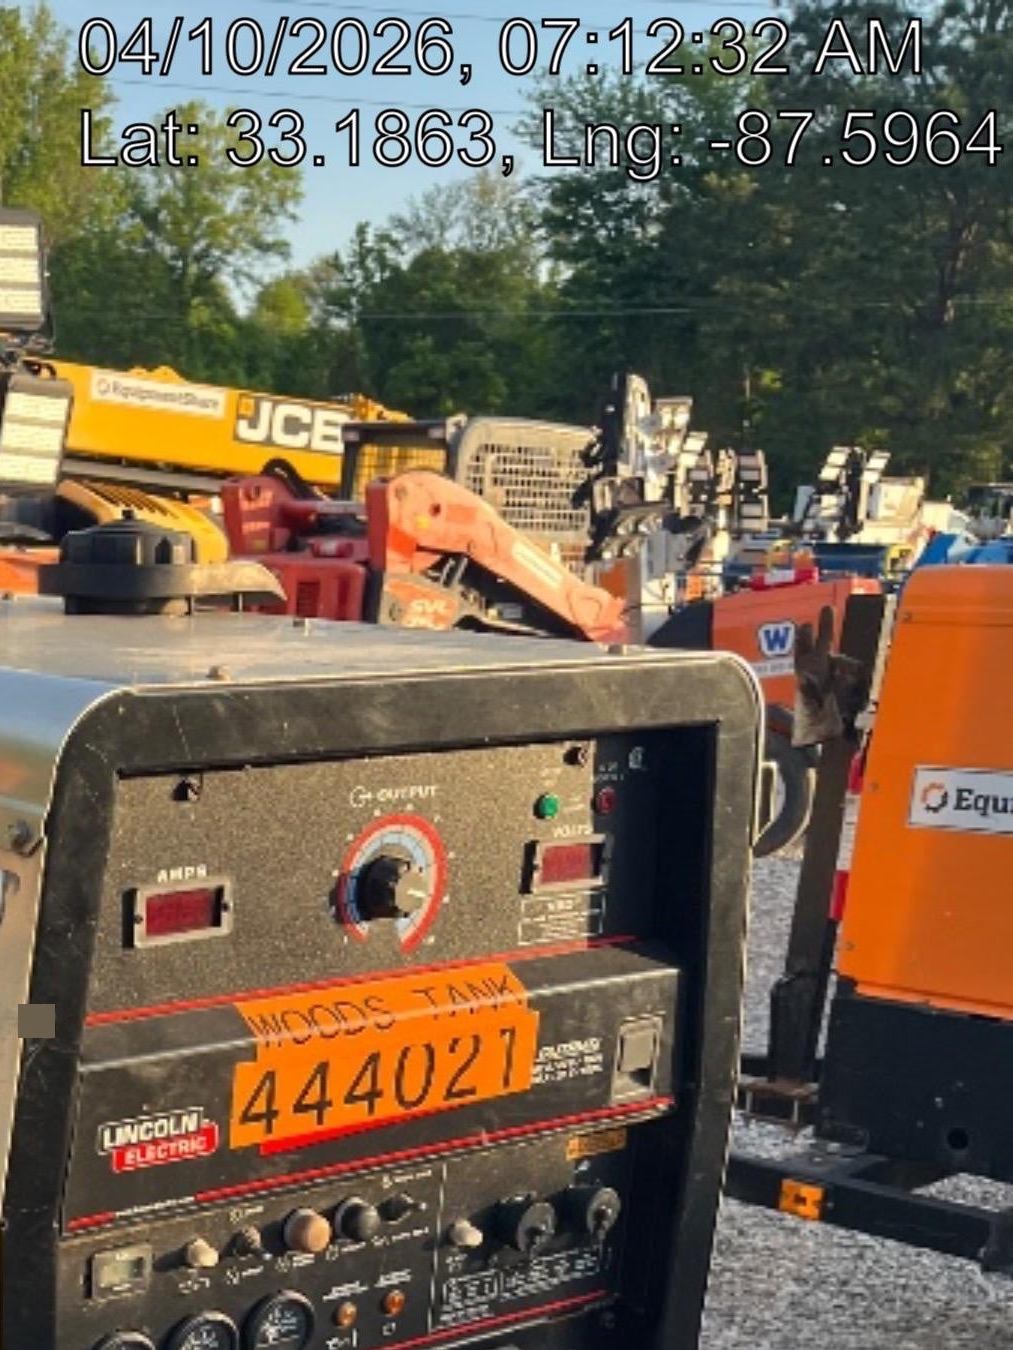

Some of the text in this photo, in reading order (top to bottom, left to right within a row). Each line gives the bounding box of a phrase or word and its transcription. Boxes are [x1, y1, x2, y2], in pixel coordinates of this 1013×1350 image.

[376, 784, 437, 802] OUTPUT
[953, 786, 1013, 817] Equ
[246, 974, 525, 1049] WOODS TANK
[239, 1025, 517, 1135] 444021
[103, 1112, 199, 1150] LINCOLN
[124, 1136, 208, 1166] ELECTRIC
